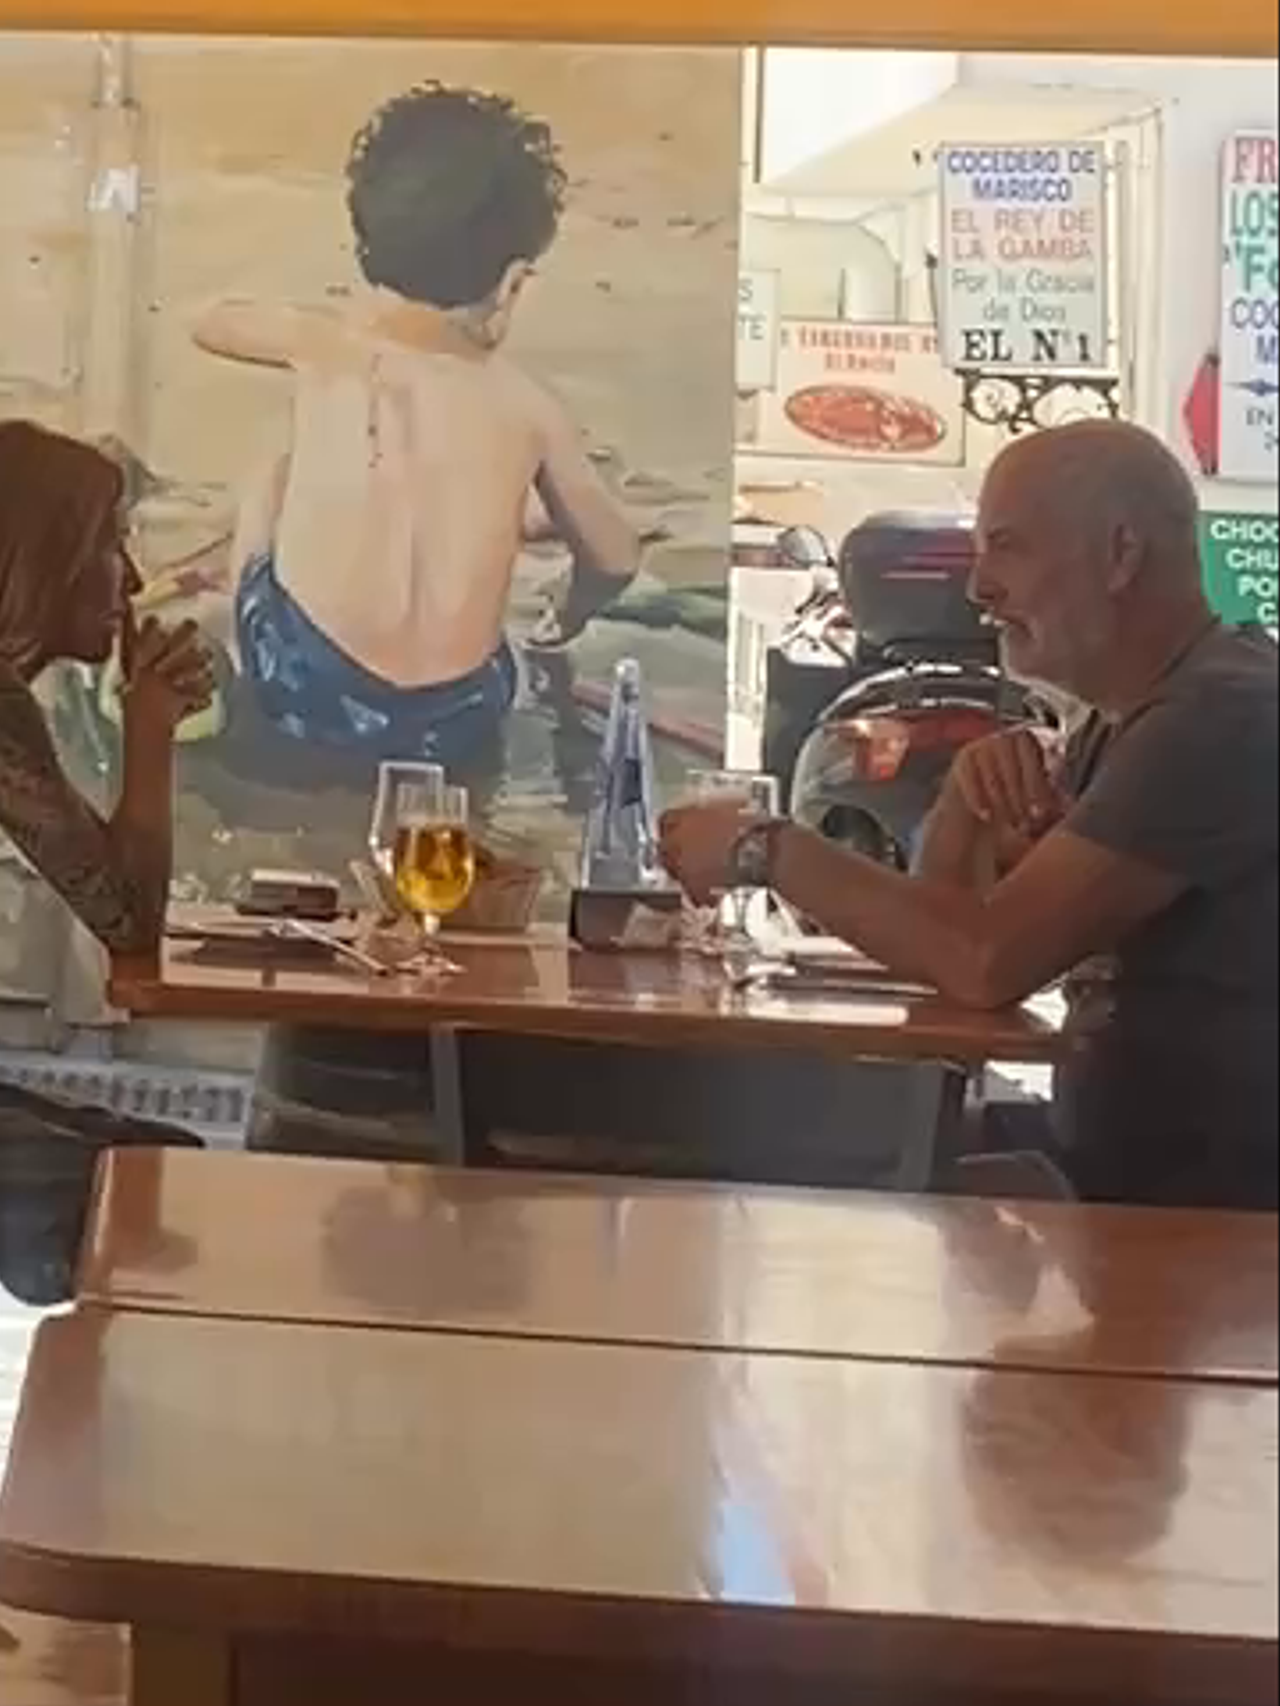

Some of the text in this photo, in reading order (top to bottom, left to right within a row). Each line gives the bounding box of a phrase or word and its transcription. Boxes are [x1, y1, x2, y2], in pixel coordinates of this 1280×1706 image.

[948, 150, 1095, 173] COCEDERO DE
[973, 179, 1071, 201] MARISCO
[951, 208, 1094, 233] EL REY DE
[954, 238, 1094, 261] LA GAMBA
[952, 268, 986, 292] Por
[997, 268, 1016, 292] la
[983, 297, 1067, 322] de Dios
[961, 329, 1013, 362] EL
